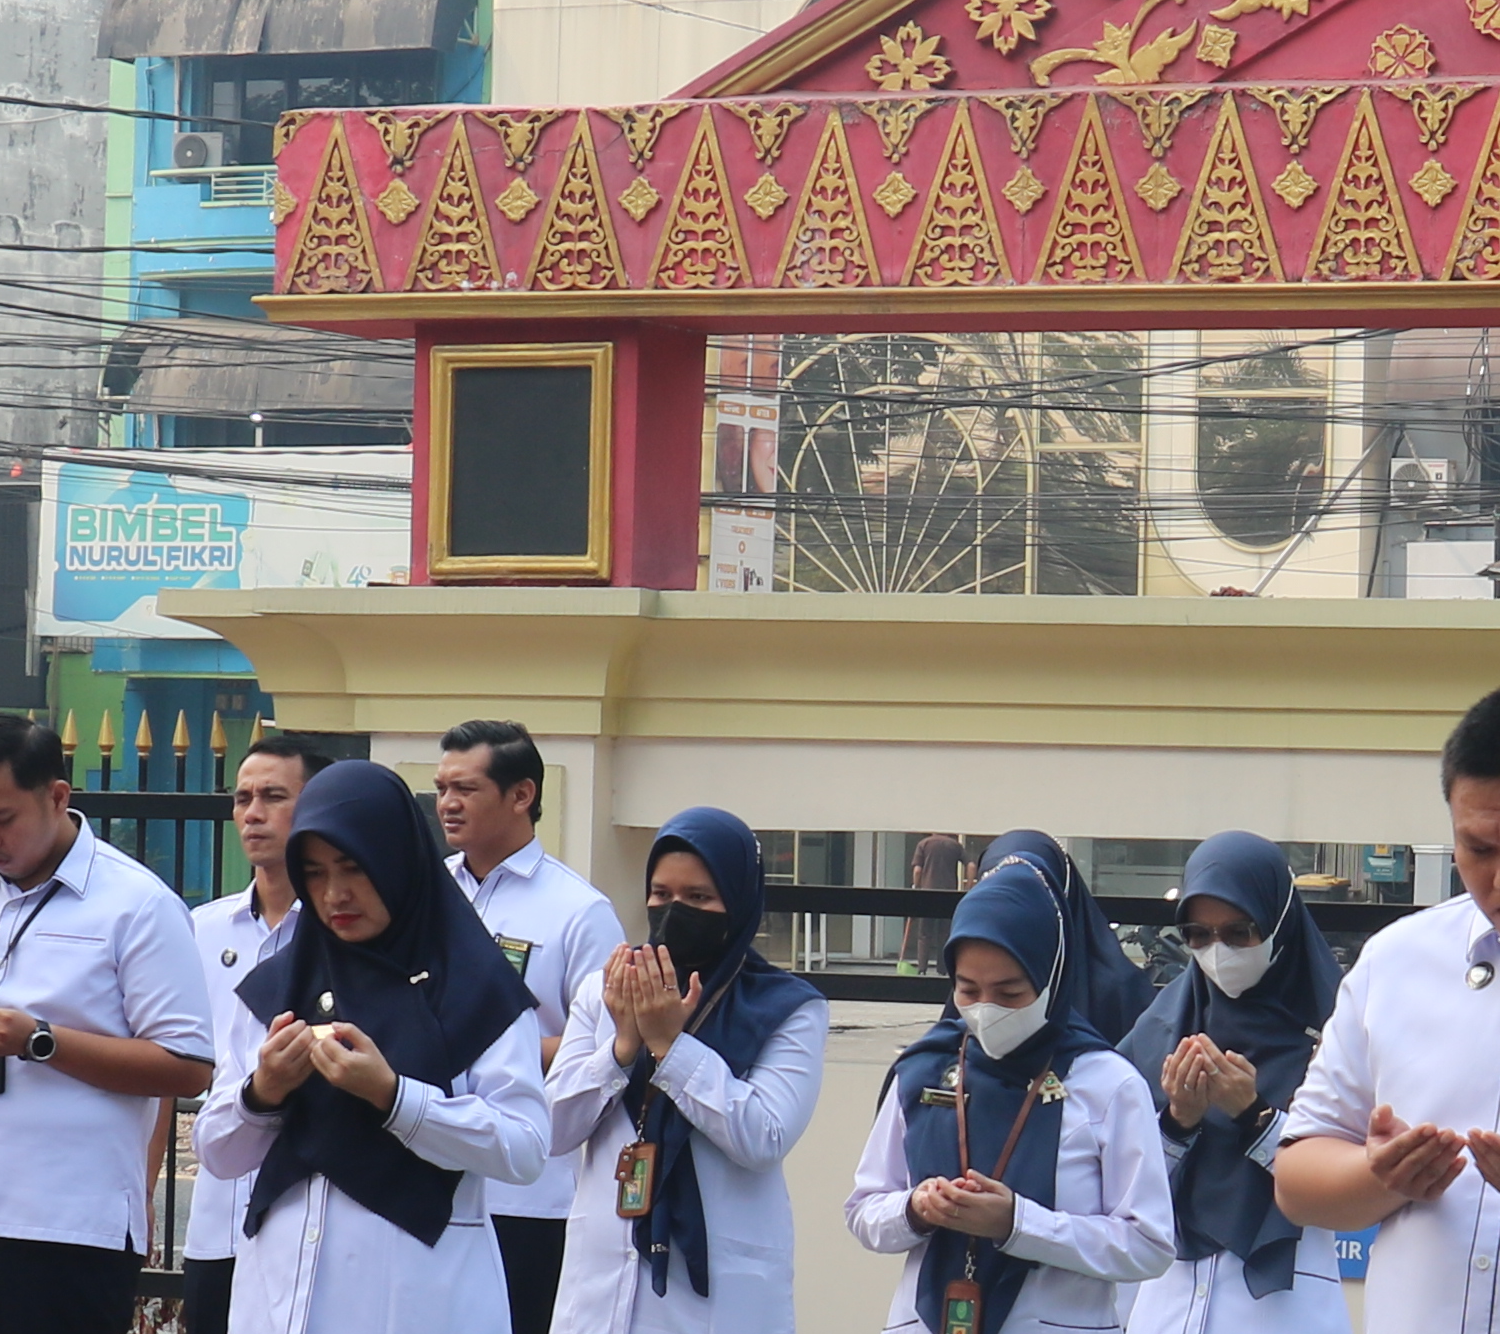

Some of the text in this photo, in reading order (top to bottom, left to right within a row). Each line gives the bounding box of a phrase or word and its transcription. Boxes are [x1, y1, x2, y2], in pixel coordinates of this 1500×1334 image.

[69, 507, 235, 543] BIMBEL
[68, 544, 234, 567] NURUL FIKRI
[1335, 1239, 1363, 1261] KIR
